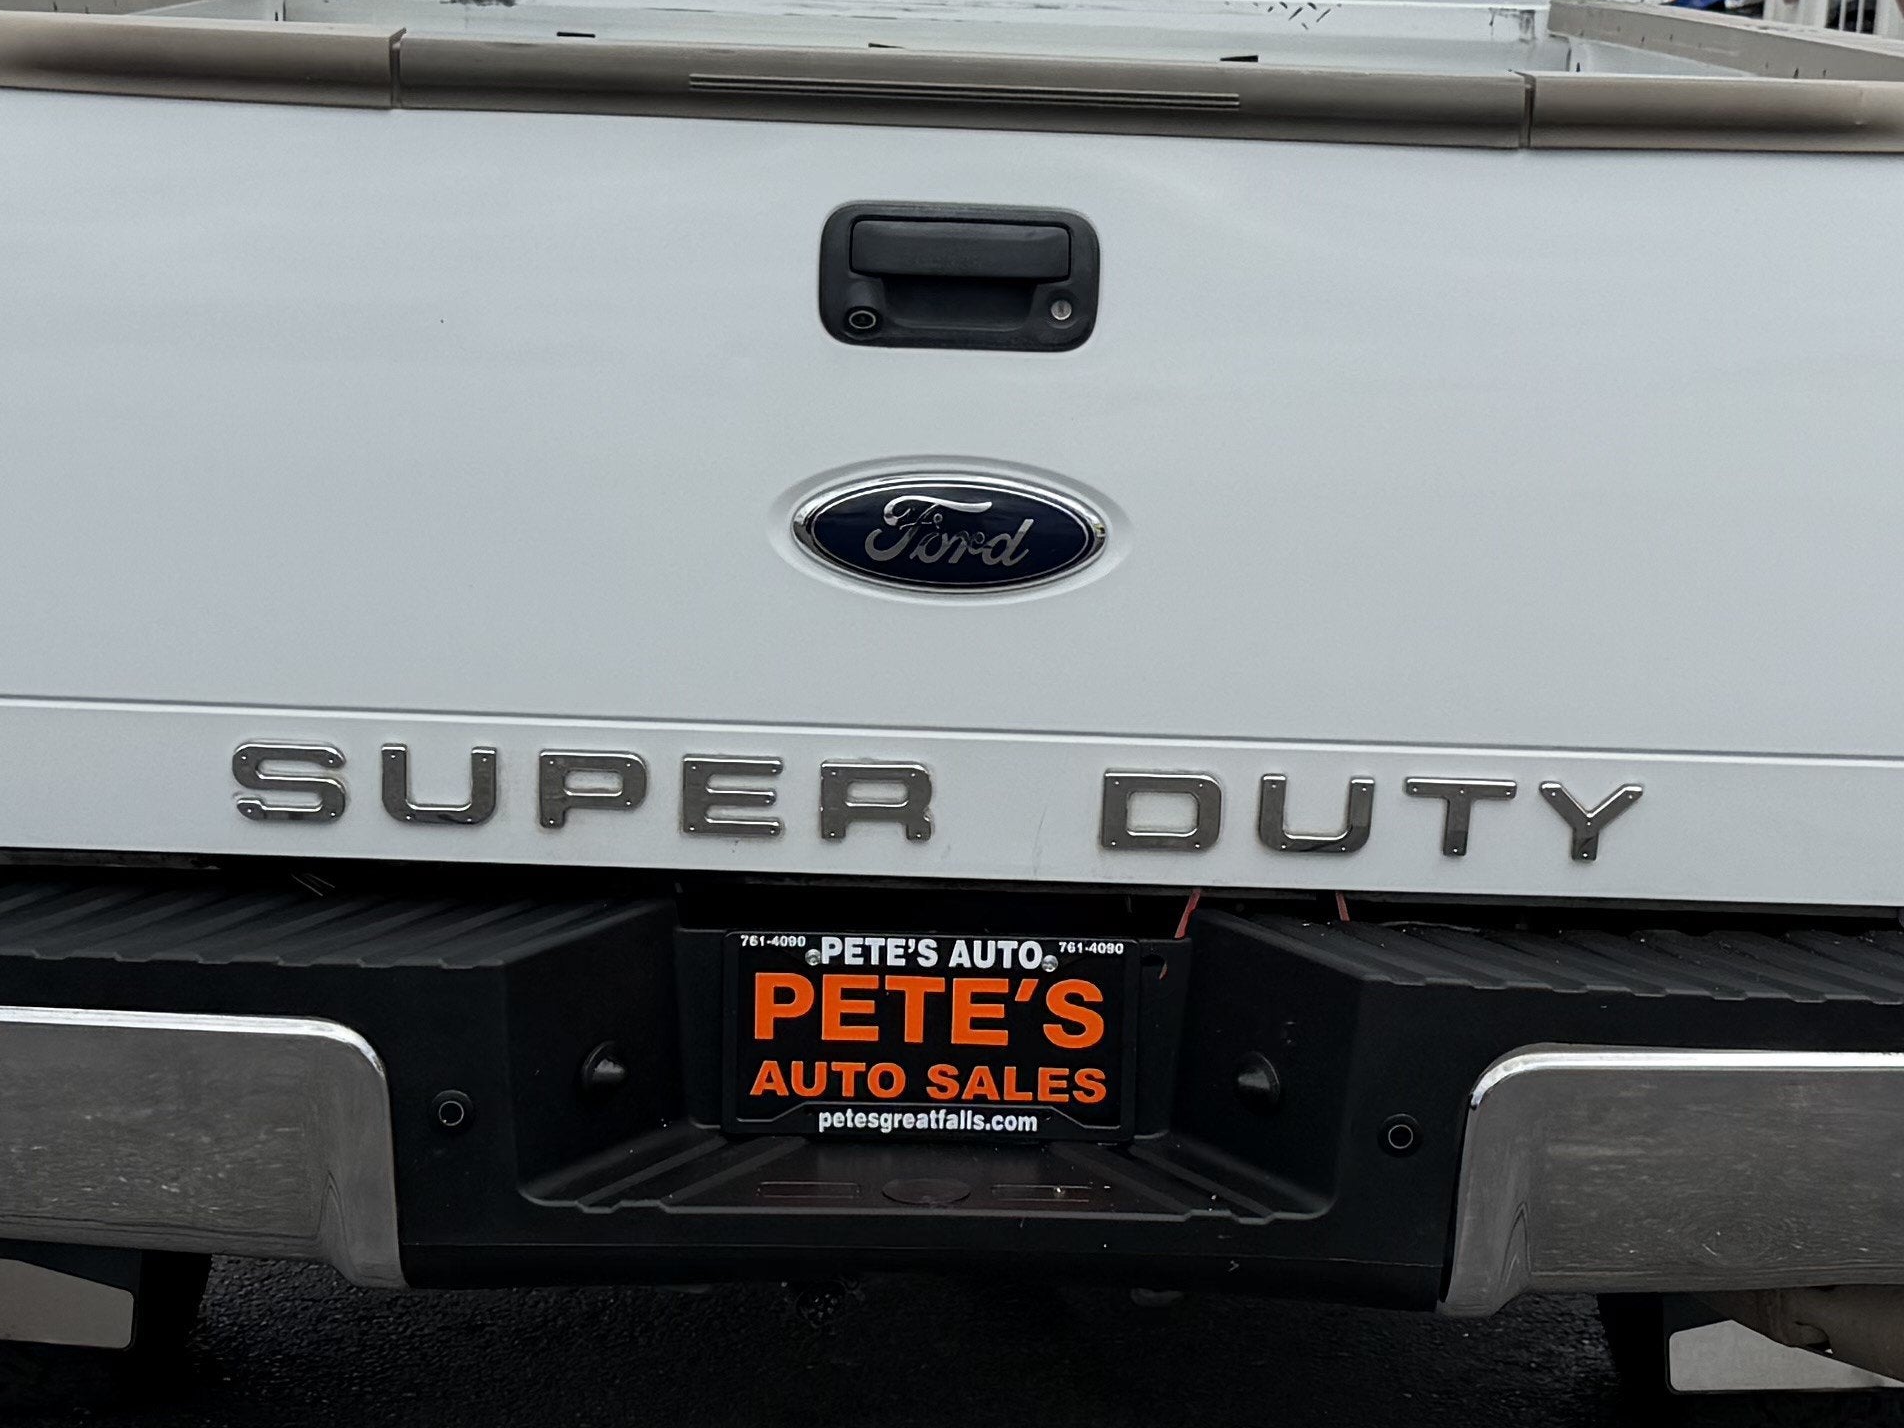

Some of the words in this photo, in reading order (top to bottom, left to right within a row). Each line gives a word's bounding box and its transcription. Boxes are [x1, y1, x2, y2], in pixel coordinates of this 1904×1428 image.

[864, 495, 1035, 567] Ford
[232, 740, 936, 844] SUPER
[1098, 767, 1646, 864] DUTY
[740, 934, 807, 948] 761-4090
[820, 936, 938, 968] PETE'S
[948, 939, 1043, 970] AUTO
[1058, 941, 1124, 955] 761-4090
[753, 971, 1106, 1049] PETE'S
[749, 1060, 907, 1099] AUTO
[925, 1064, 1107, 1104] SALES
[817, 1108, 1038, 1134] petesgreatfalls.com
